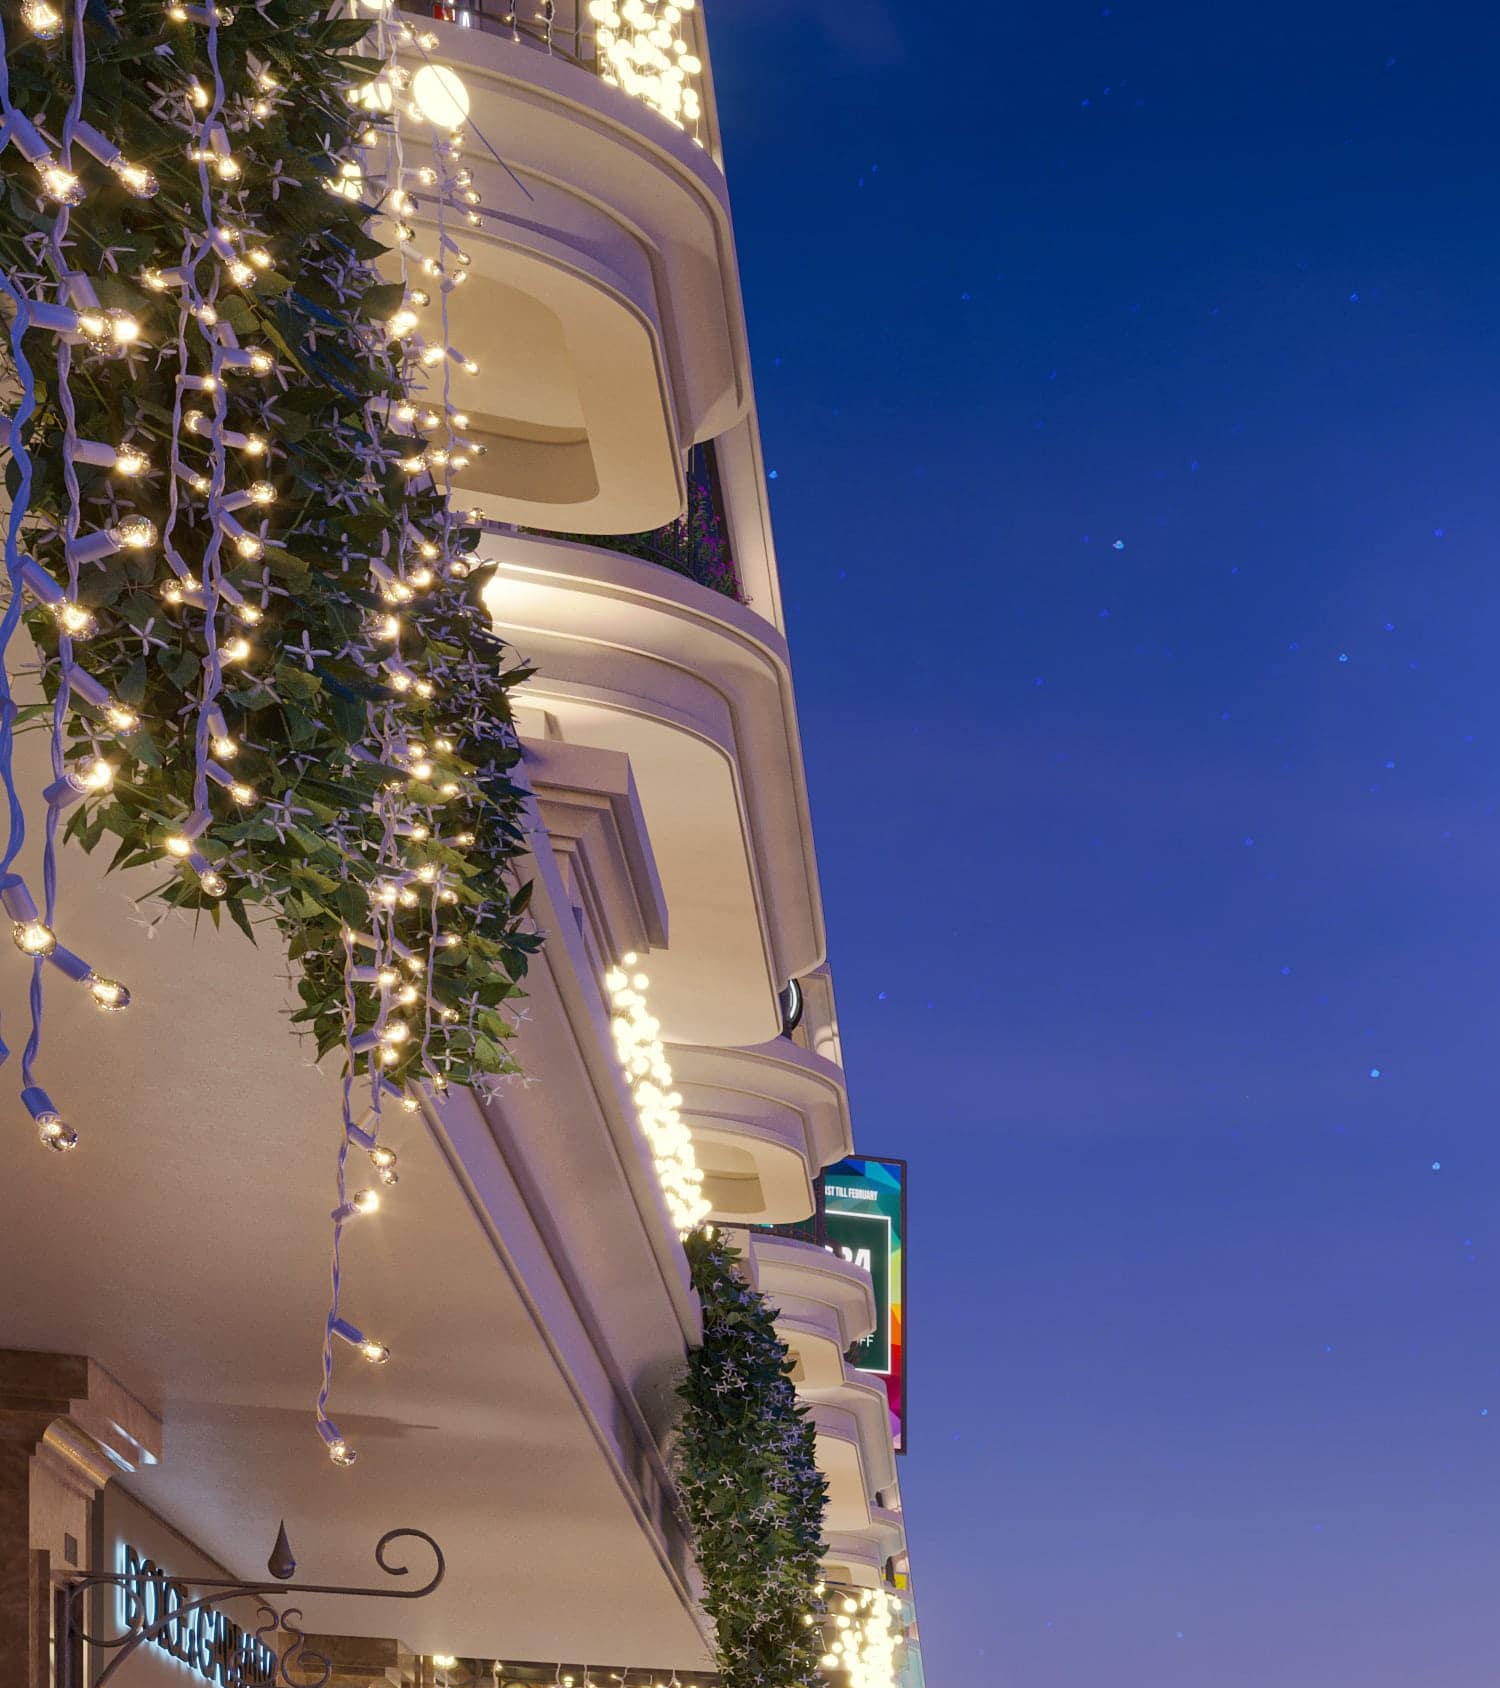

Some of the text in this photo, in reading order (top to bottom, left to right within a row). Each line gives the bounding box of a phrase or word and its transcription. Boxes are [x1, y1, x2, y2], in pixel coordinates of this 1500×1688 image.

[835, 1186, 848, 1198] TILL
[849, 1187, 878, 1201] FEBRUARY
[856, 1334, 874, 1348] FF
